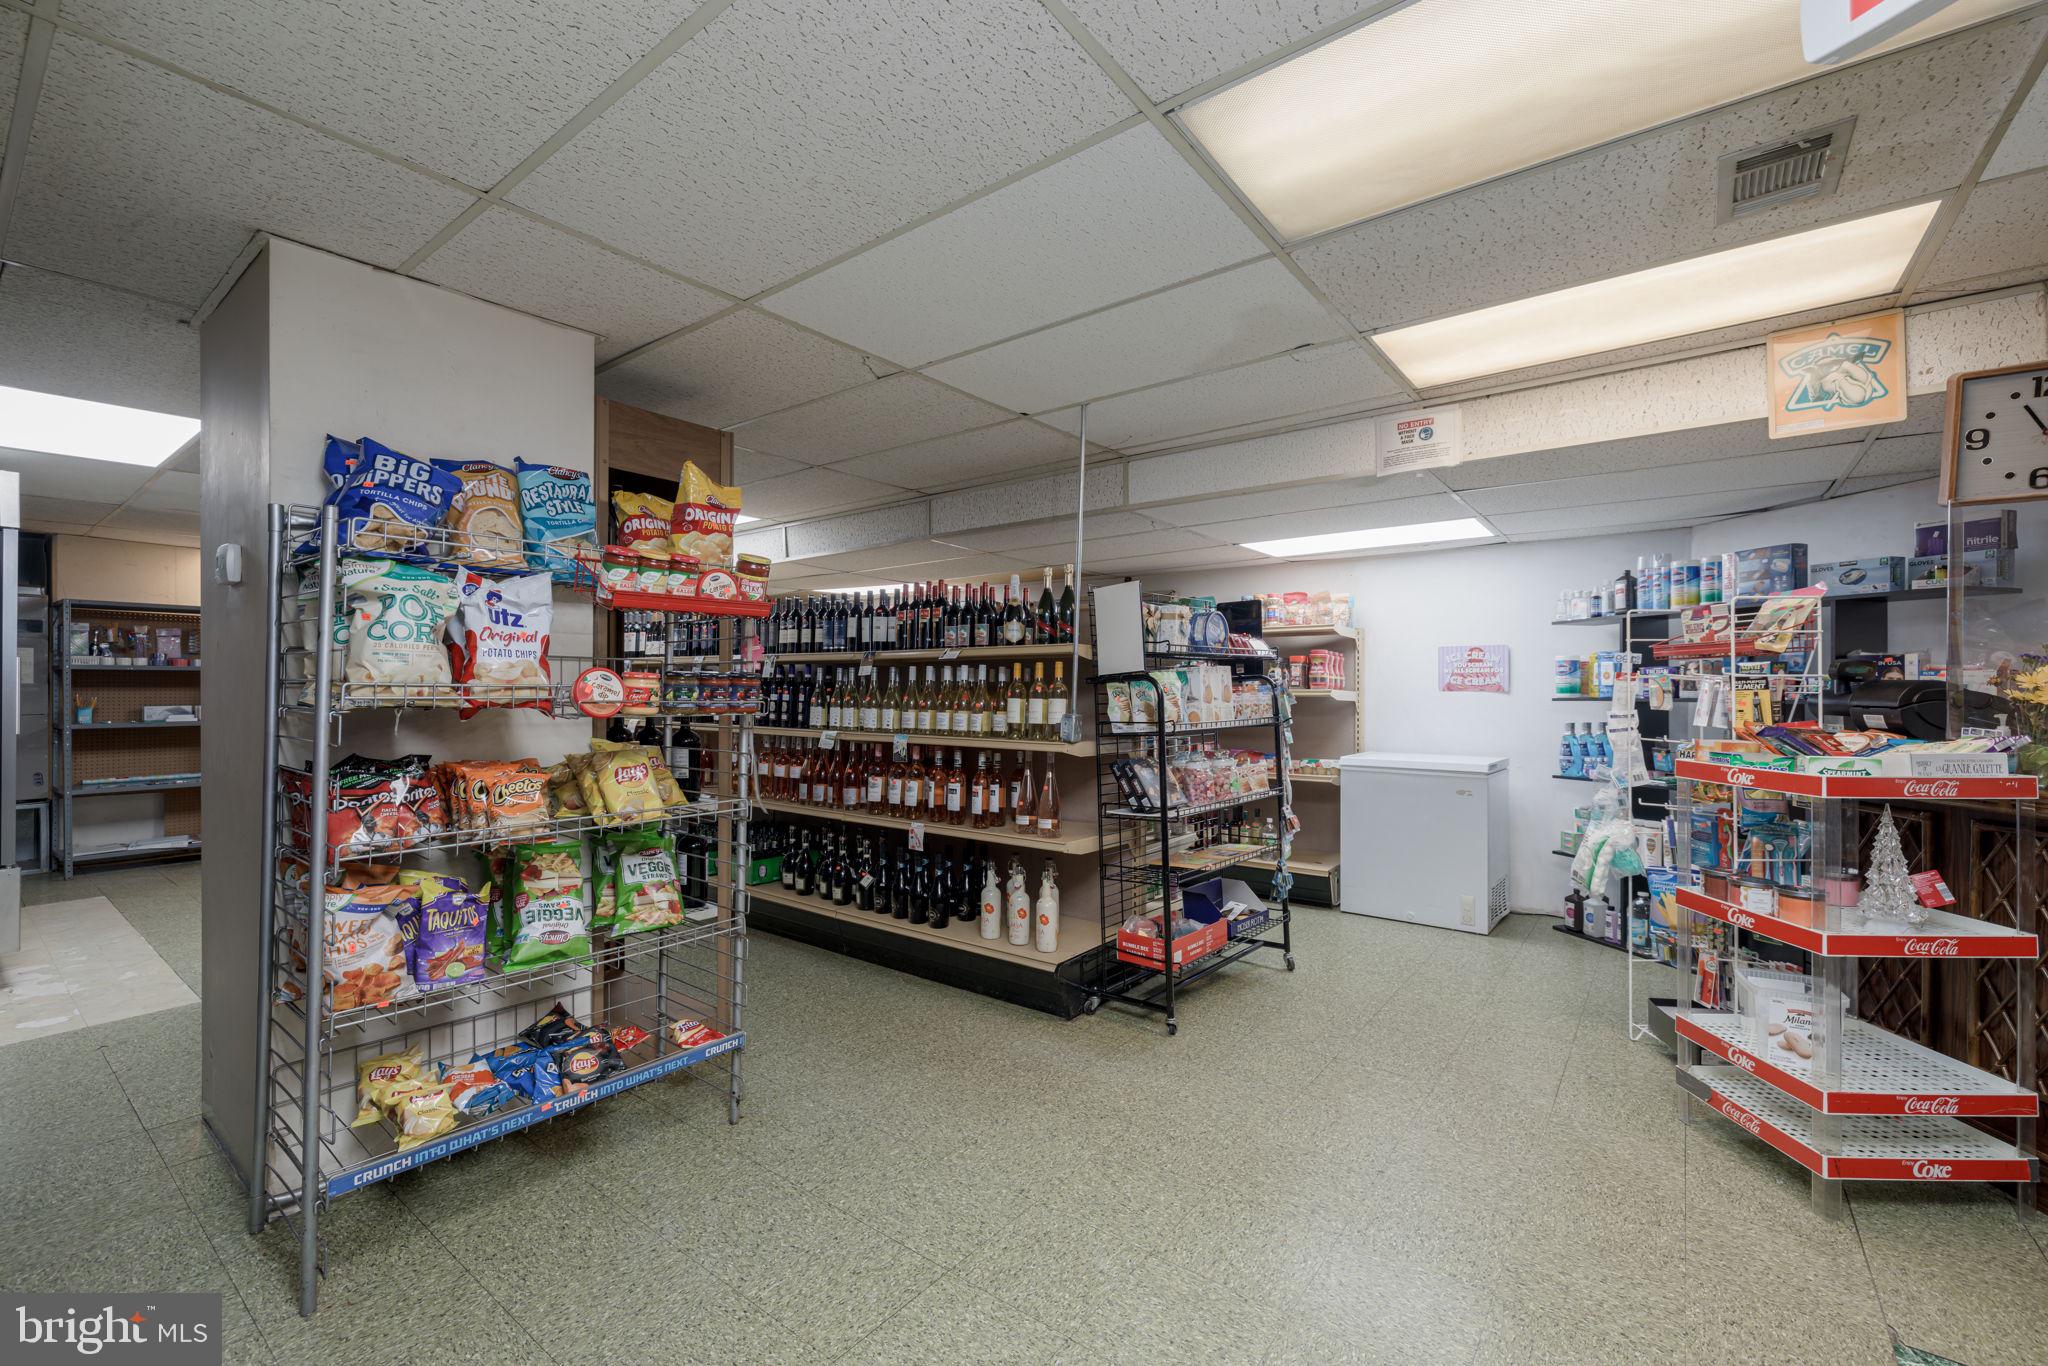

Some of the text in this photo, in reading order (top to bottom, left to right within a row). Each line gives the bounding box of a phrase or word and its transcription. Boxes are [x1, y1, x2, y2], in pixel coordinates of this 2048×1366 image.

[1790, 342, 1877, 368] CAMEL
[1411, 419, 1433, 428] ENTRY
[1965, 429, 1990, 451] 9
[2029, 466, 2048, 489] 6
[359, 488, 428, 511] TORTILLA CHIPS
[545, 500, 585, 517] STYLE
[1967, 535, 2000, 546] nitrile
[381, 584, 437, 599] Sea Salt
[479, 626, 539, 647] Original
[482, 648, 537, 659] POTATO CHIPS
[591, 682, 621, 697] caramel
[598, 692, 609, 701] dip
[1727, 767, 1755, 785] Coke
[1973, 763, 2003, 774] GALETTE
[402, 786, 437, 803] oritos
[493, 779, 543, 807] Cheetos
[1904, 779, 1960, 797] Coca-Cola
[526, 908, 584, 924] VEGGIE
[1727, 908, 1756, 929] Coke
[1904, 938, 1960, 955] Coca-Cola
[677, 1021, 700, 1033] Frito
[1784, 1015, 1814, 1026] Milan
[705, 1039, 739, 1058] CRUNCH
[1727, 1047, 1756, 1071] Coke
[555, 1056, 690, 1112] CRUNCH INTO WHAT'S NEXT
[1904, 1096, 1960, 1114] Coca-Cola
[1722, 1101, 1761, 1134] Coca-Cola
[354, 1112, 534, 1186] CRUNCH INTO WHAT'S NEXT
[1913, 1160, 1952, 1178] Coke
